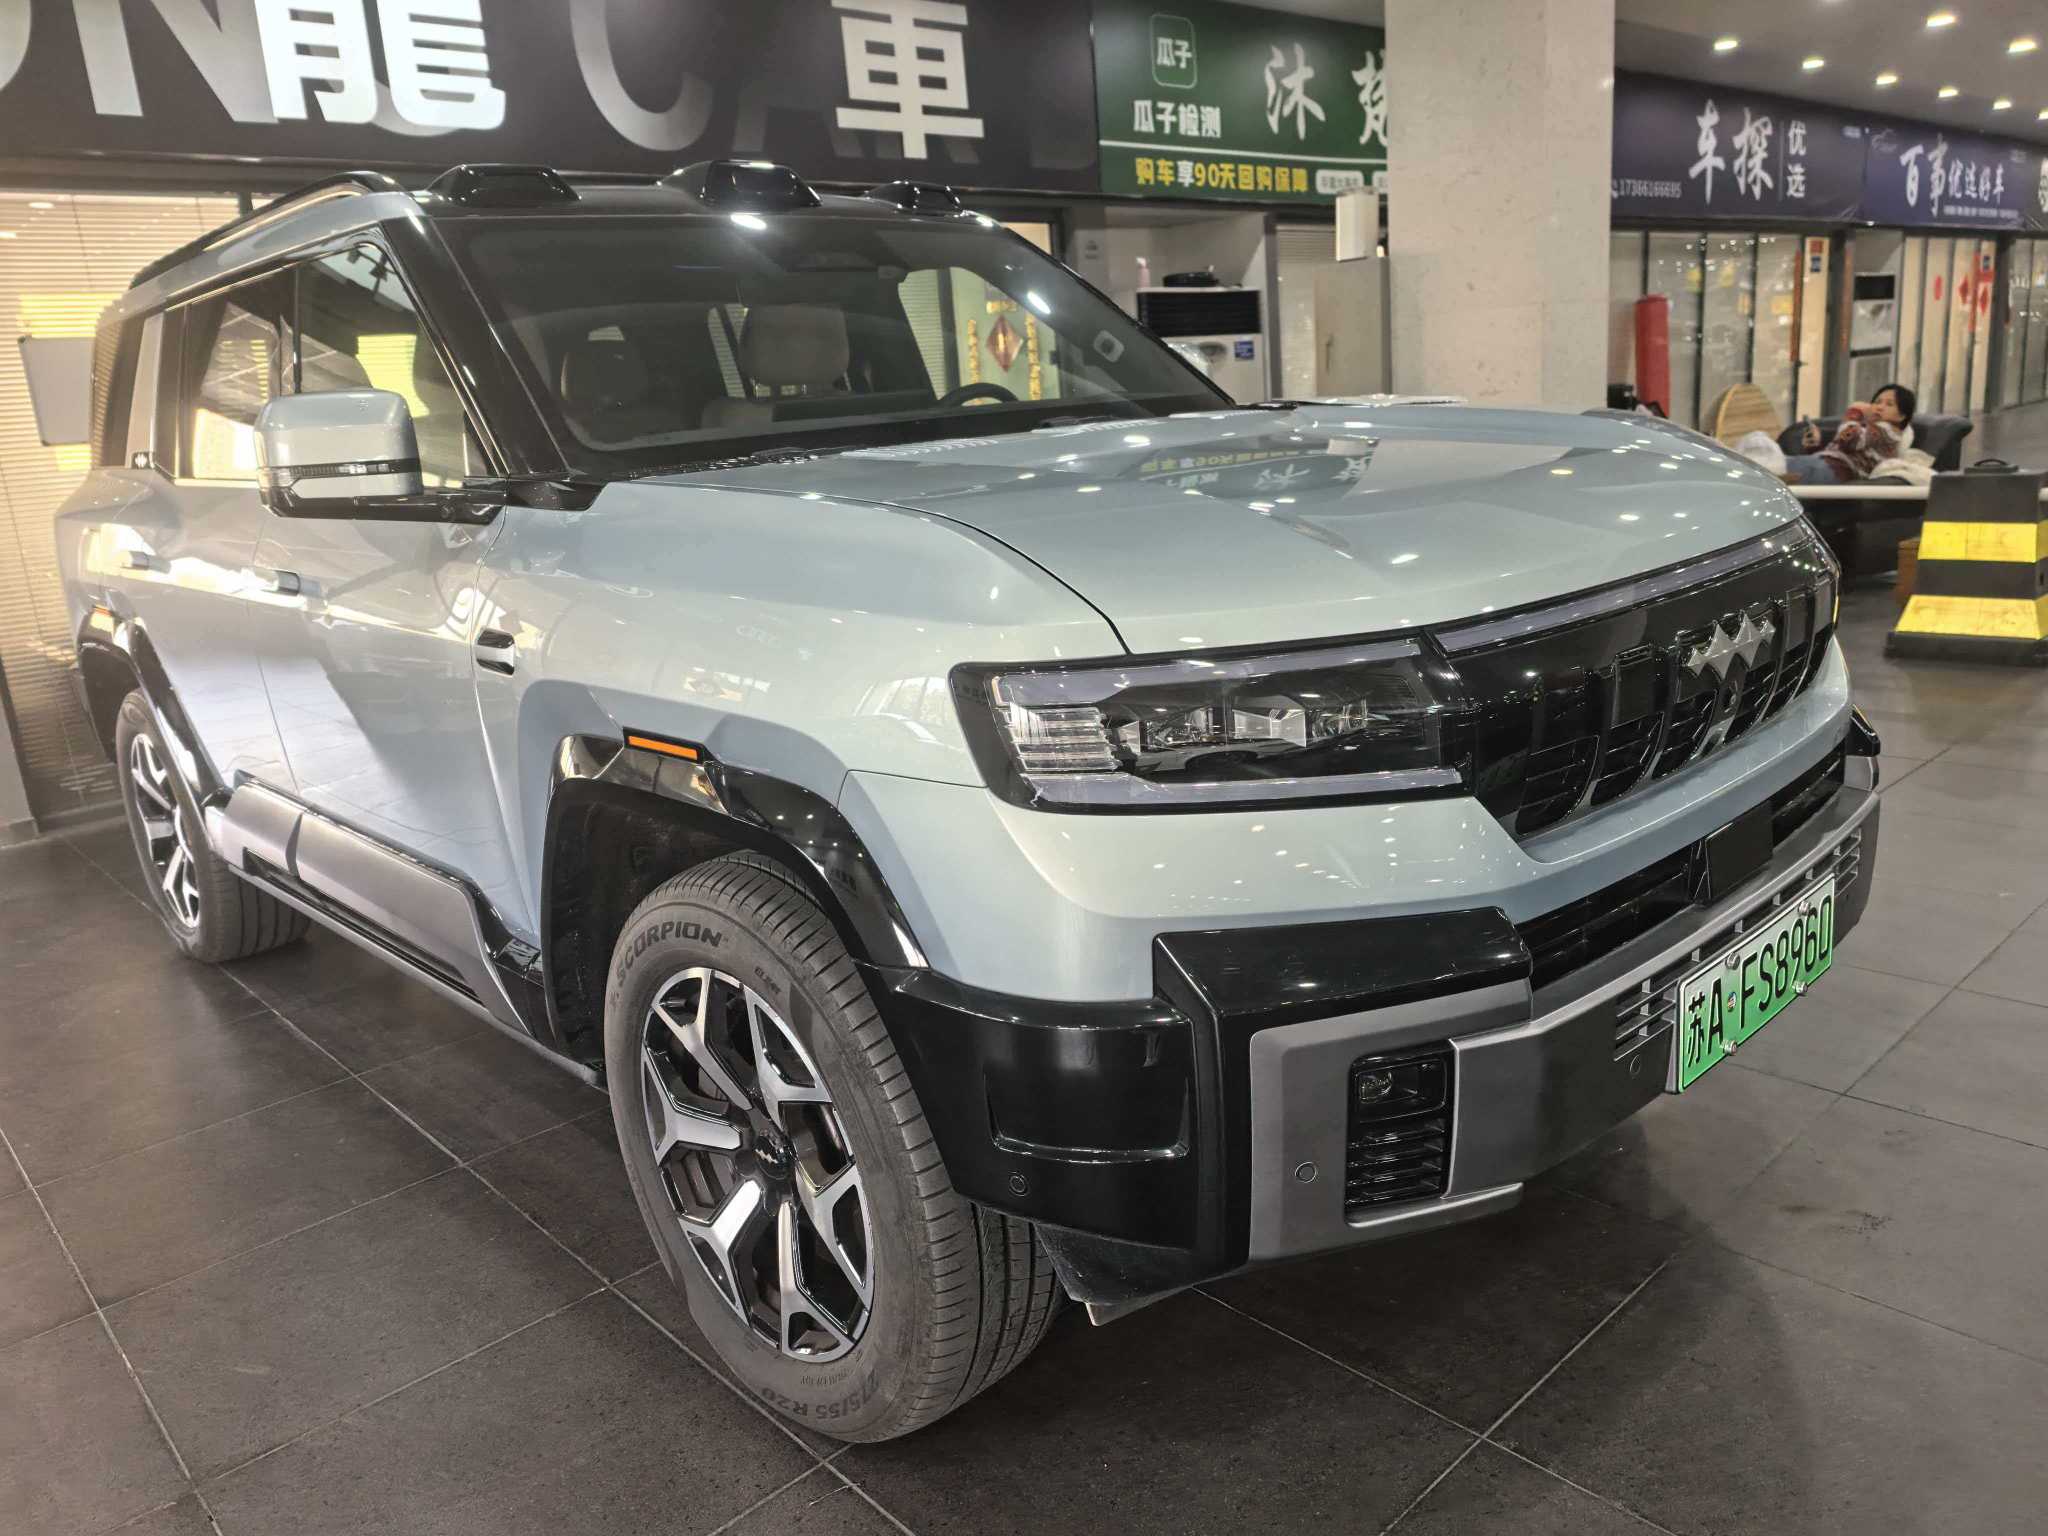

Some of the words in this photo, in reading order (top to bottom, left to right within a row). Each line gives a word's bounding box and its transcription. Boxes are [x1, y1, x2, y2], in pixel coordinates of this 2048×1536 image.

[1156, 36, 1192, 69] 瓜子
[1133, 99, 1222, 139] 瓜子检测
[617, 920, 723, 987] SCORPION
